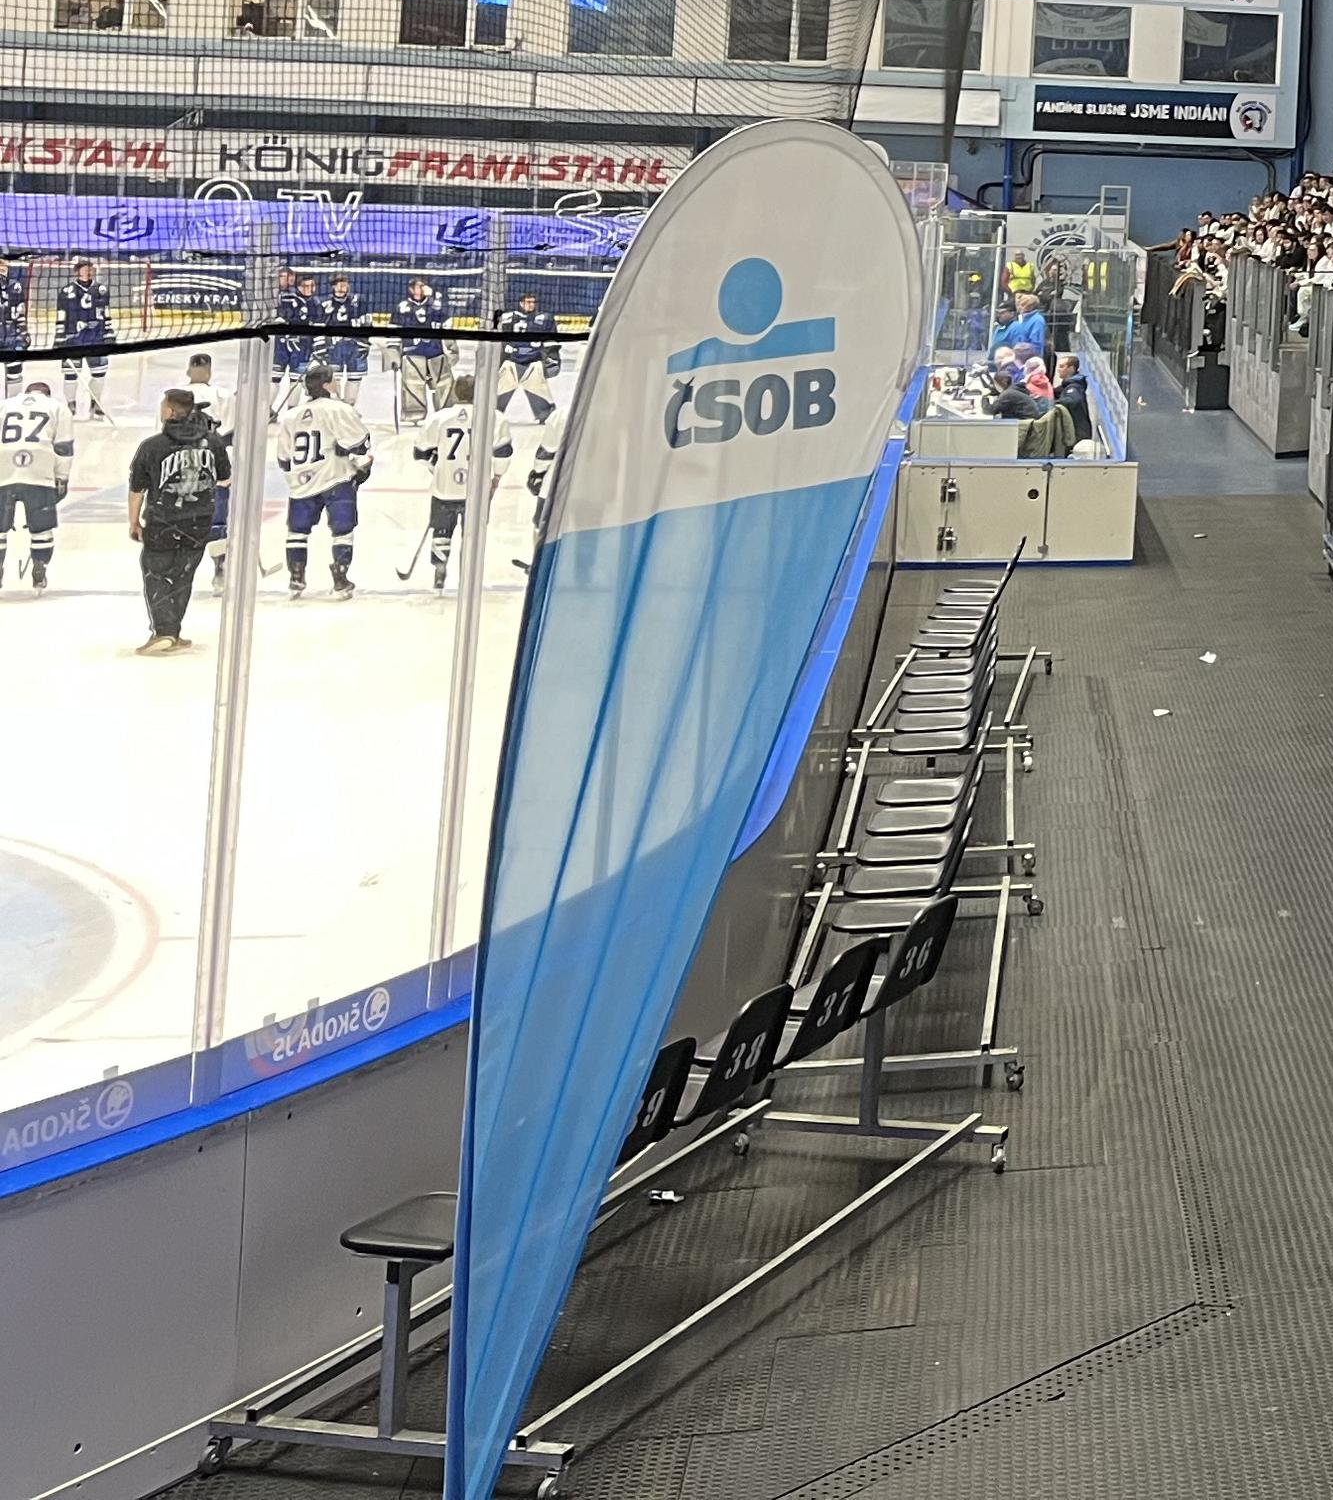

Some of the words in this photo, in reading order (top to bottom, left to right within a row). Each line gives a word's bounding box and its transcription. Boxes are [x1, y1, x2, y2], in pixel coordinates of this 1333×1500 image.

[1130, 103, 1170, 120] JSME
[1173, 103, 1227, 122] INDIÁNI
[219, 134, 384, 178] KÖNIG
[1, 411, 50, 444] 67
[664, 367, 837, 449] ČSOB
[293, 429, 326, 465] 91
[899, 936, 934, 980] 36
[816, 981, 855, 1028] 37
[724, 1031, 768, 1080] 38
